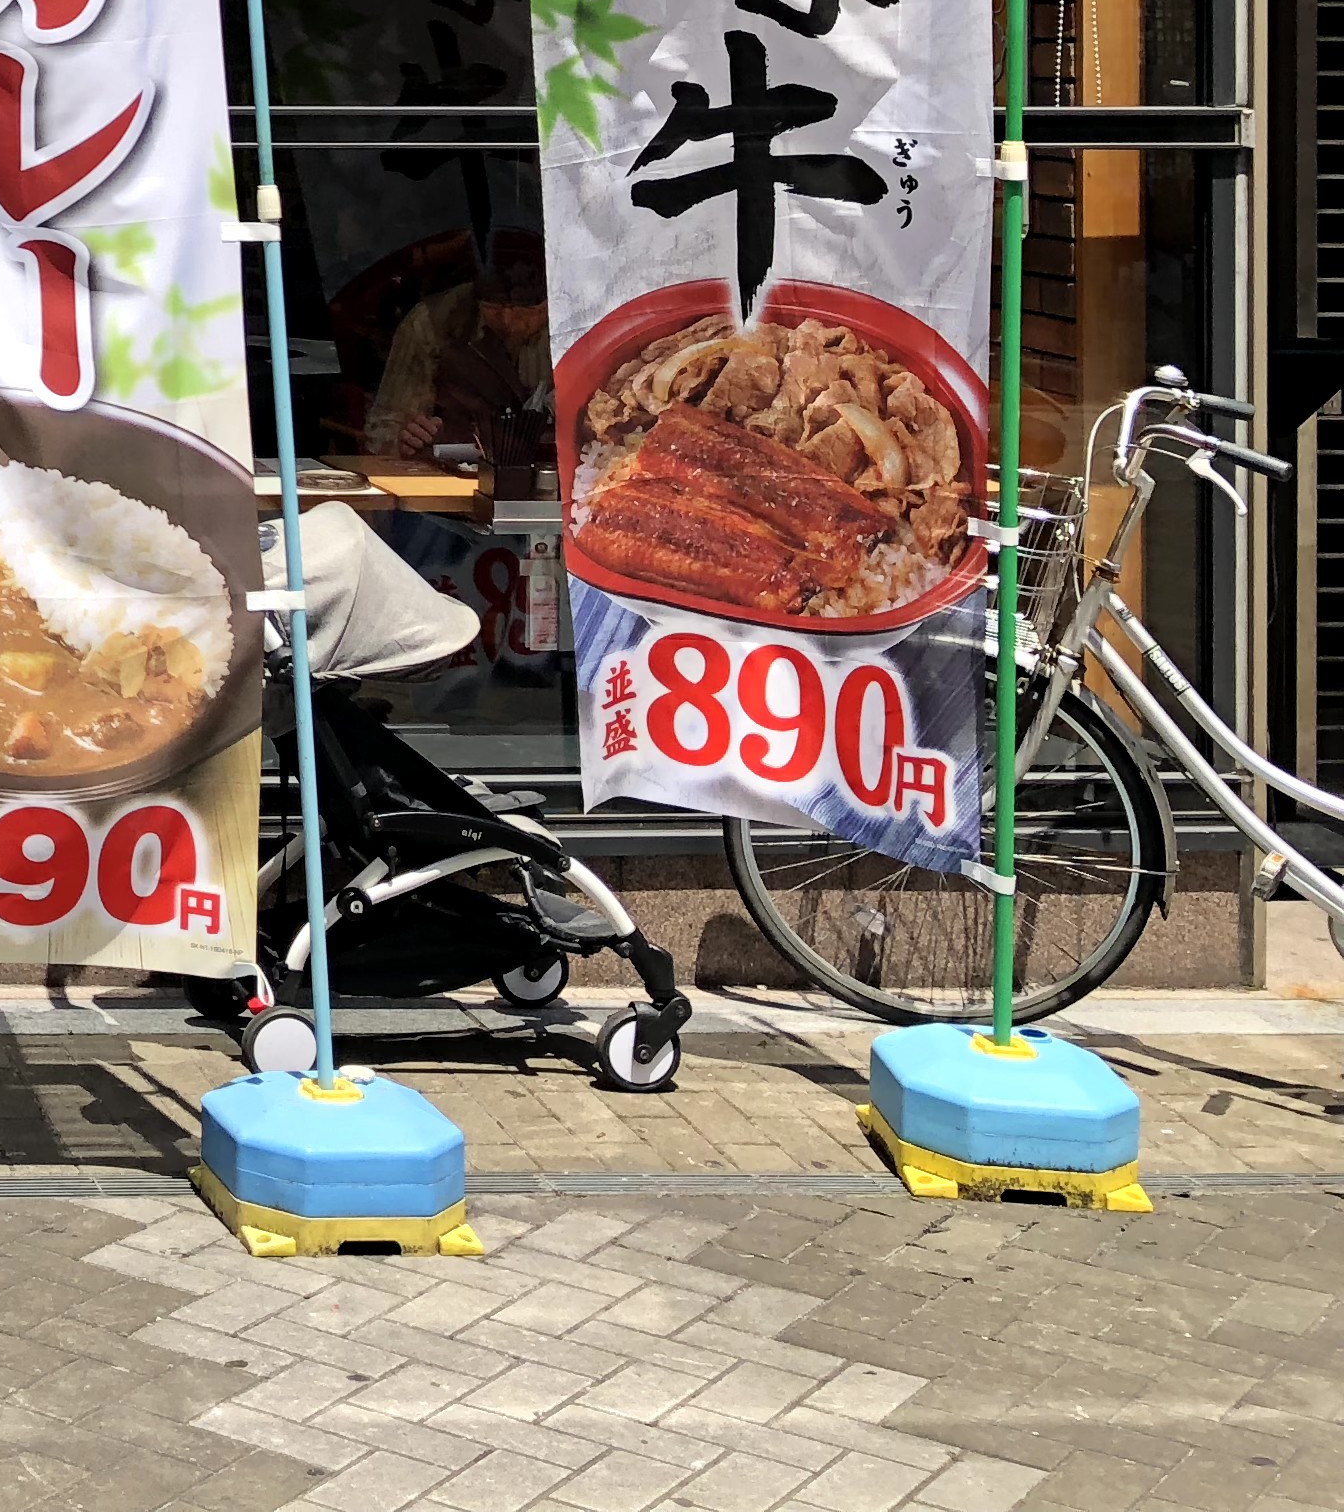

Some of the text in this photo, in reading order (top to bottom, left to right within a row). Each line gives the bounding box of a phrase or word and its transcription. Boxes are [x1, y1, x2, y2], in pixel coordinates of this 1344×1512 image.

[892, 138, 920, 231] ぎゅう
[600, 659, 639, 761] 並盛
[646, 631, 950, 829] 890円
